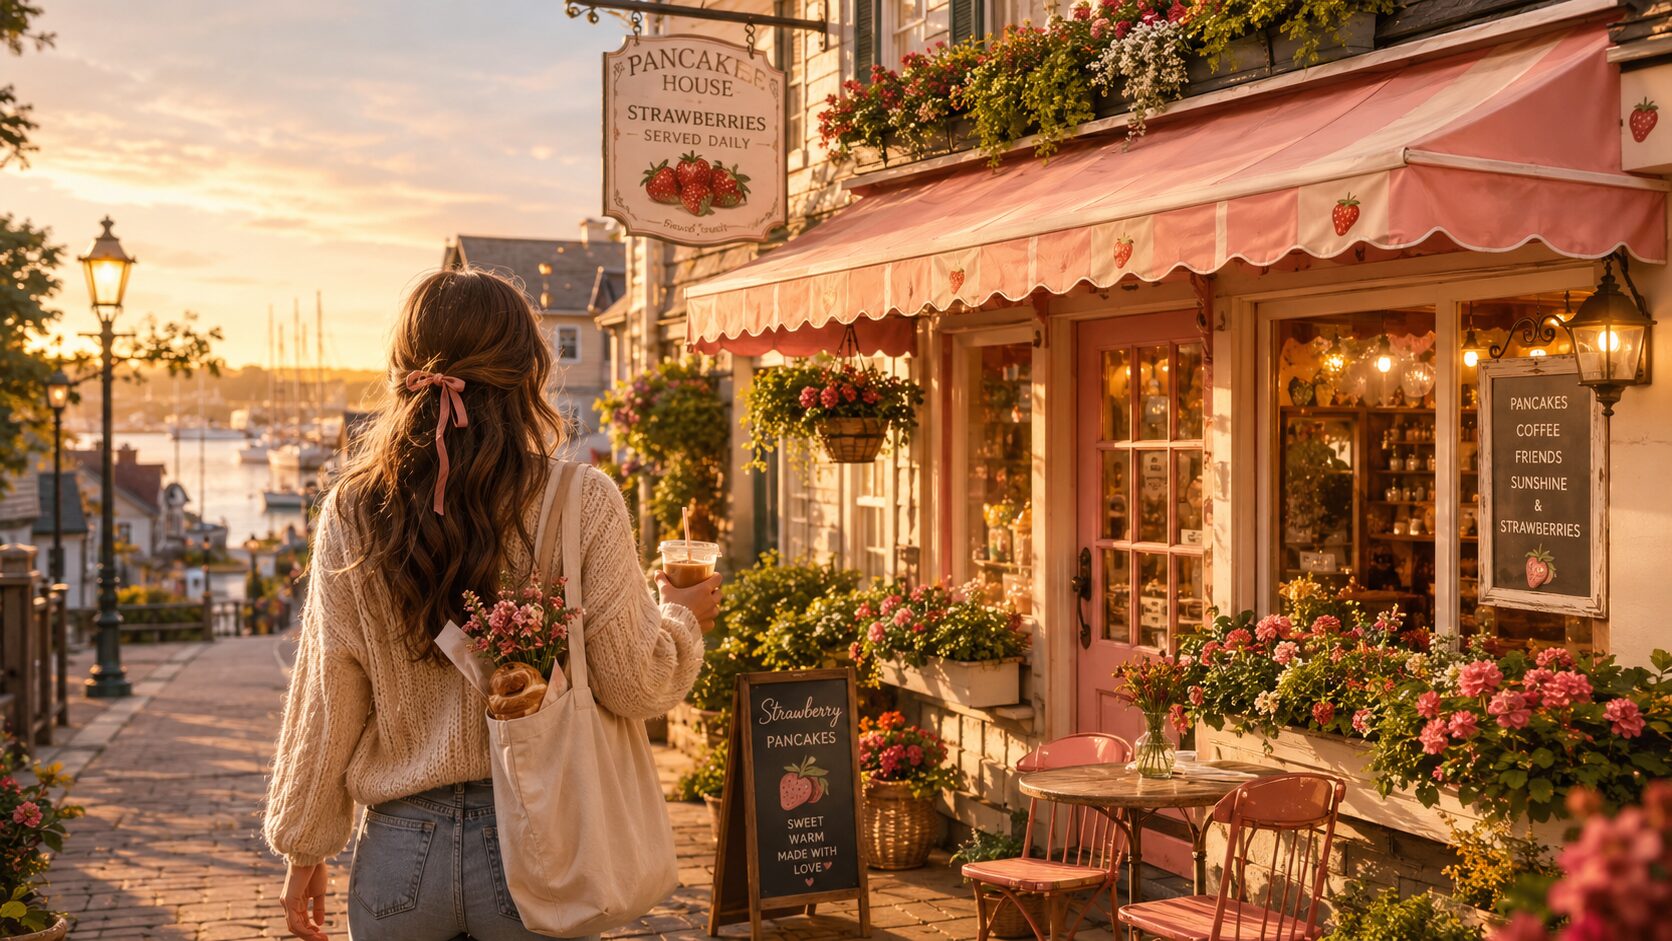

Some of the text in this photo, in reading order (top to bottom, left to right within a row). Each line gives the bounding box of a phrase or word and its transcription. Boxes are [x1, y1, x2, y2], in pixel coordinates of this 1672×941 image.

[662, 75, 733, 97] HOUSE
[628, 105, 766, 131] STRAWBERRIES
[644, 130, 750, 150] SERVED DAILY
[1511, 396, 1568, 411] PANCAKES
[1516, 424, 1560, 437] COFFEE
[1516, 451, 1562, 463] FRIENDS
[1511, 476, 1567, 491] SUNSHINE
[1534, 499, 1542, 511] &
[1501, 520, 1581, 537] STRAWBERRIES
[759, 696, 842, 727] Strawberry
[767, 732, 836, 748] PANCAKES
[788, 816, 824, 829] SWEET
[789, 832, 824, 845] WARM
[778, 846, 837, 861] MADE WITH
[794, 862, 822, 874] LOVE
